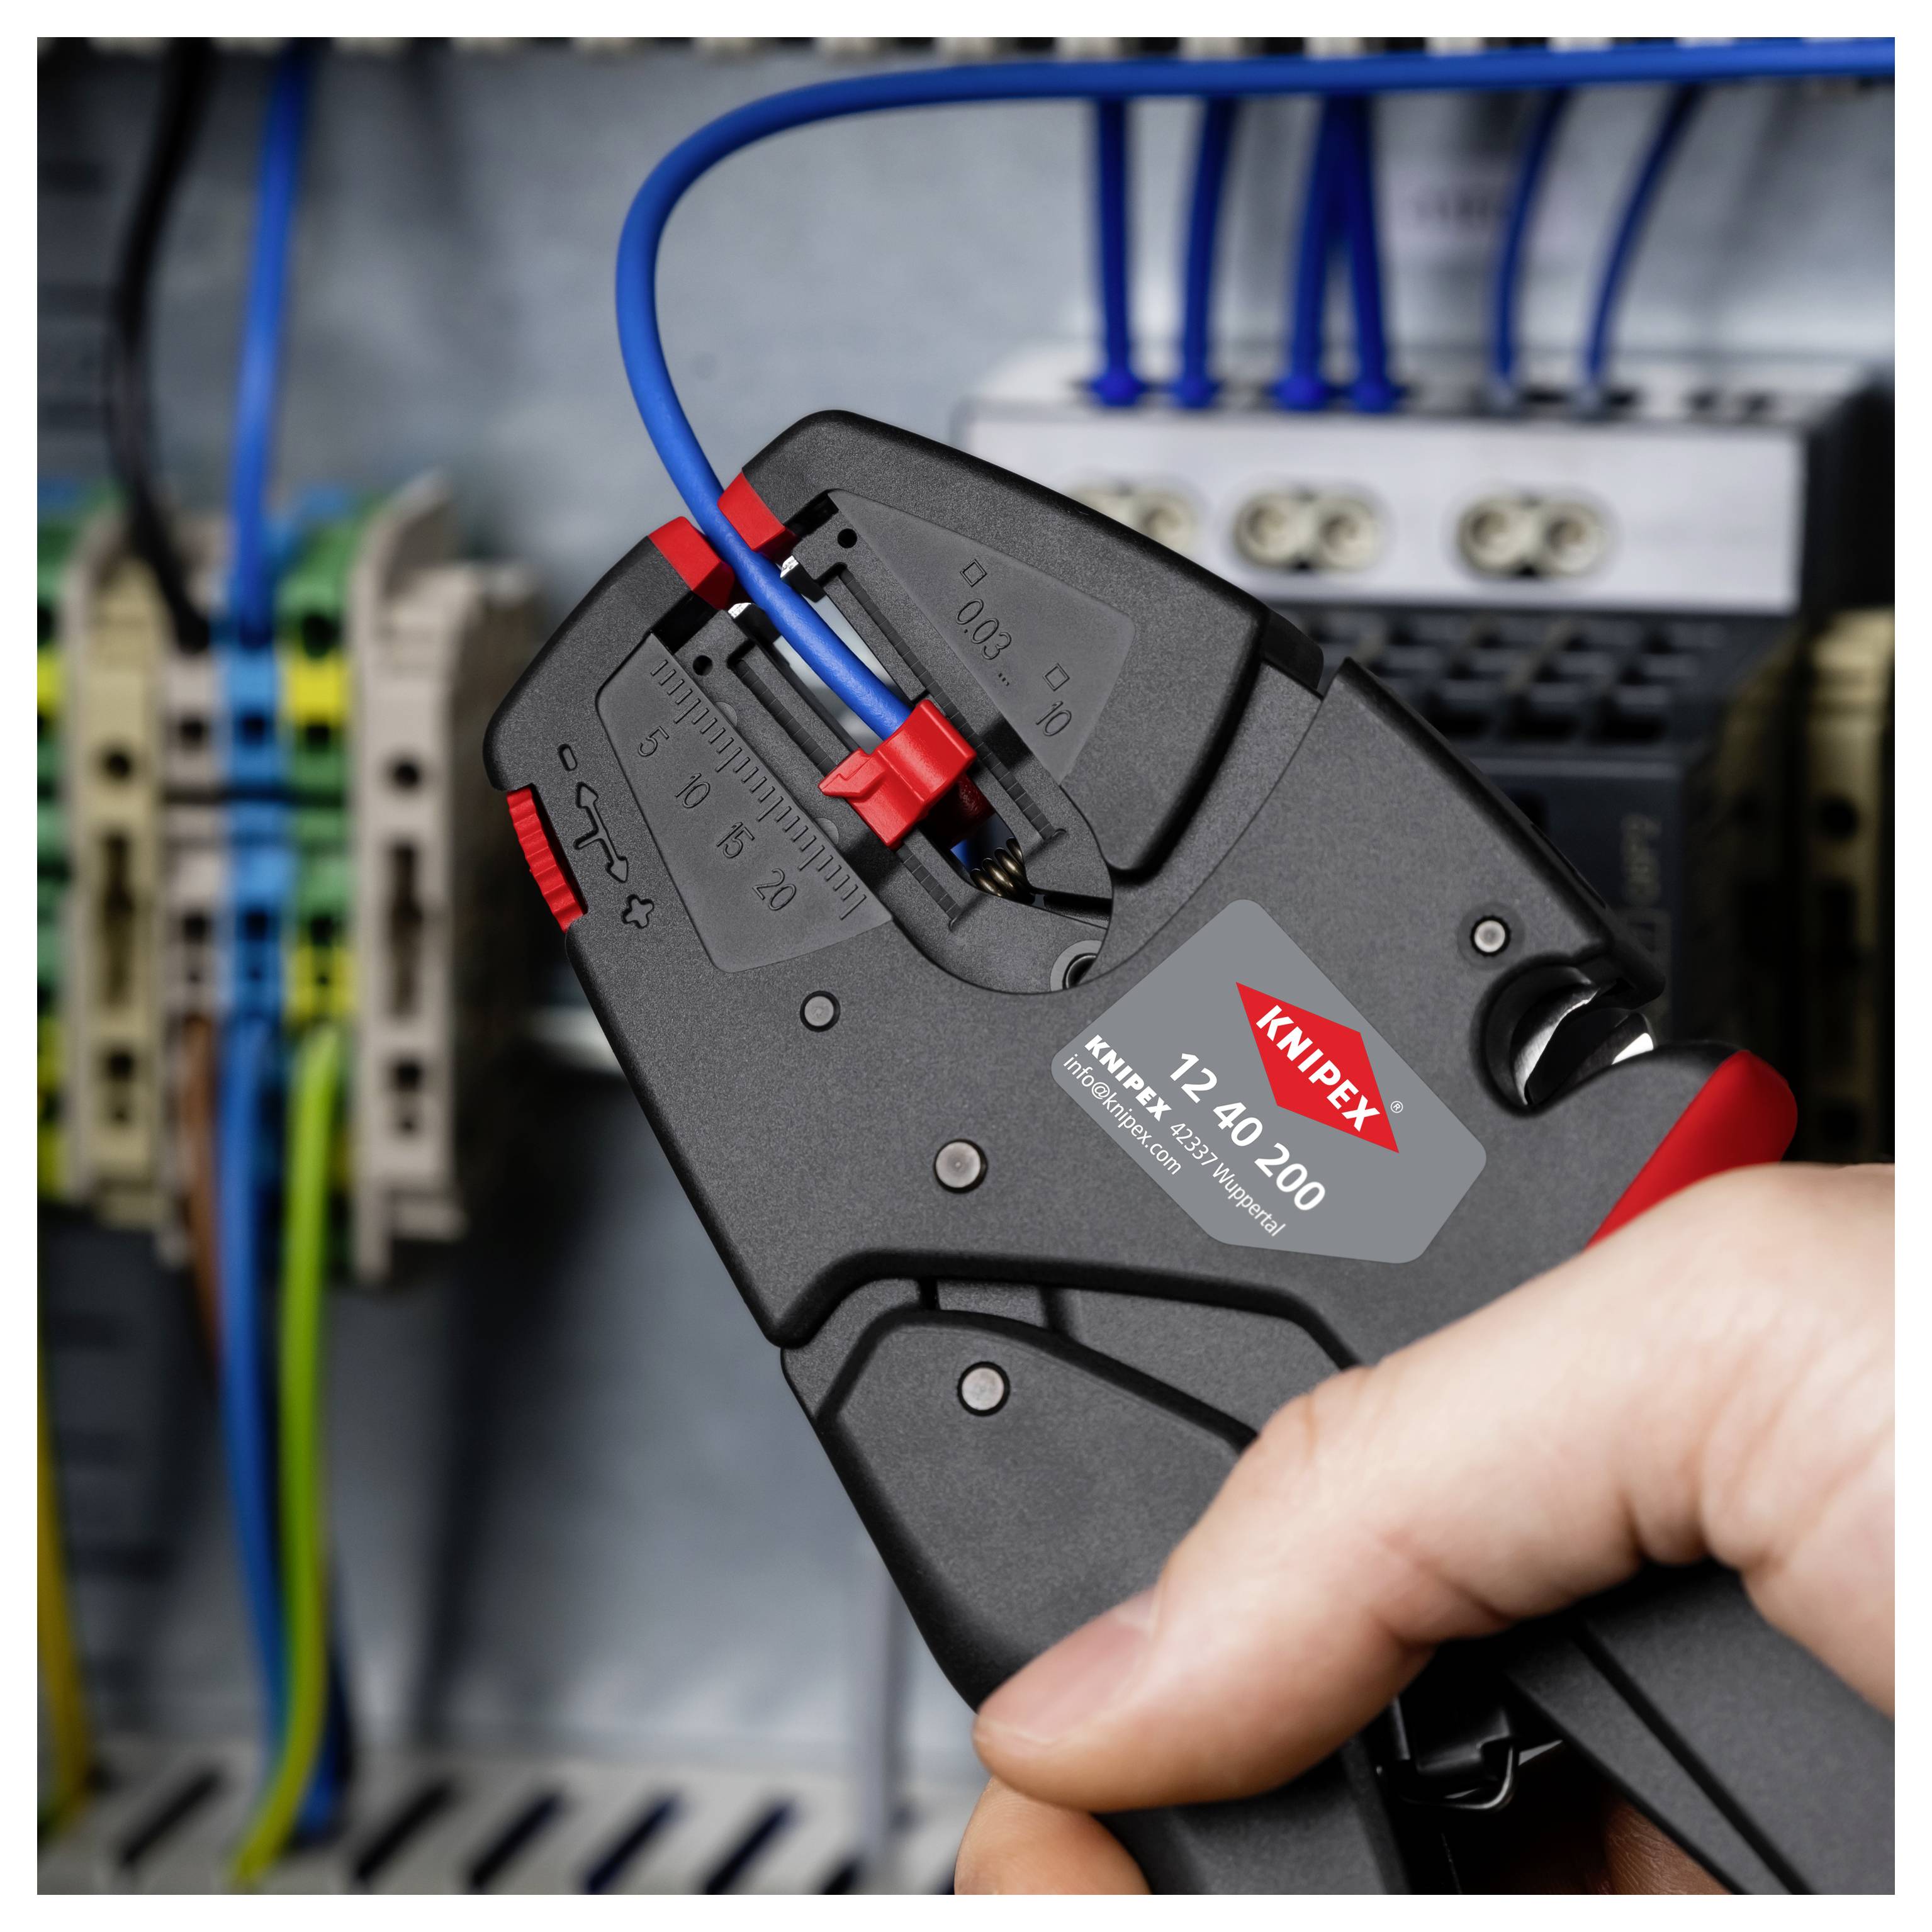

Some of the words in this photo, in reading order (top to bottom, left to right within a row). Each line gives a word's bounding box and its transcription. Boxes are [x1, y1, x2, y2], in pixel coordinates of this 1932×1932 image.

[955, 598, 1012, 660] 0.03
[1035, 700, 1072, 737] 10
[637, 725, 670, 758] 5
[674, 772, 711, 809] 10
[716, 821, 755, 859] 15
[751, 868, 797, 912] 20
[1062, 1053, 1182, 1176] info@knipex.com
[1084, 1034, 1172, 1122] KNIPEX
[1169, 1122, 1220, 1167] 42337
[1211, 1162, 1286, 1237] Wuppertal
[1169, 1052, 1218, 1104] 12
[1212, 1101, 1264, 1147] 40
[1254, 1142, 1327, 1211] 200
[1255, 1005, 1381, 1132] KNIPEX
